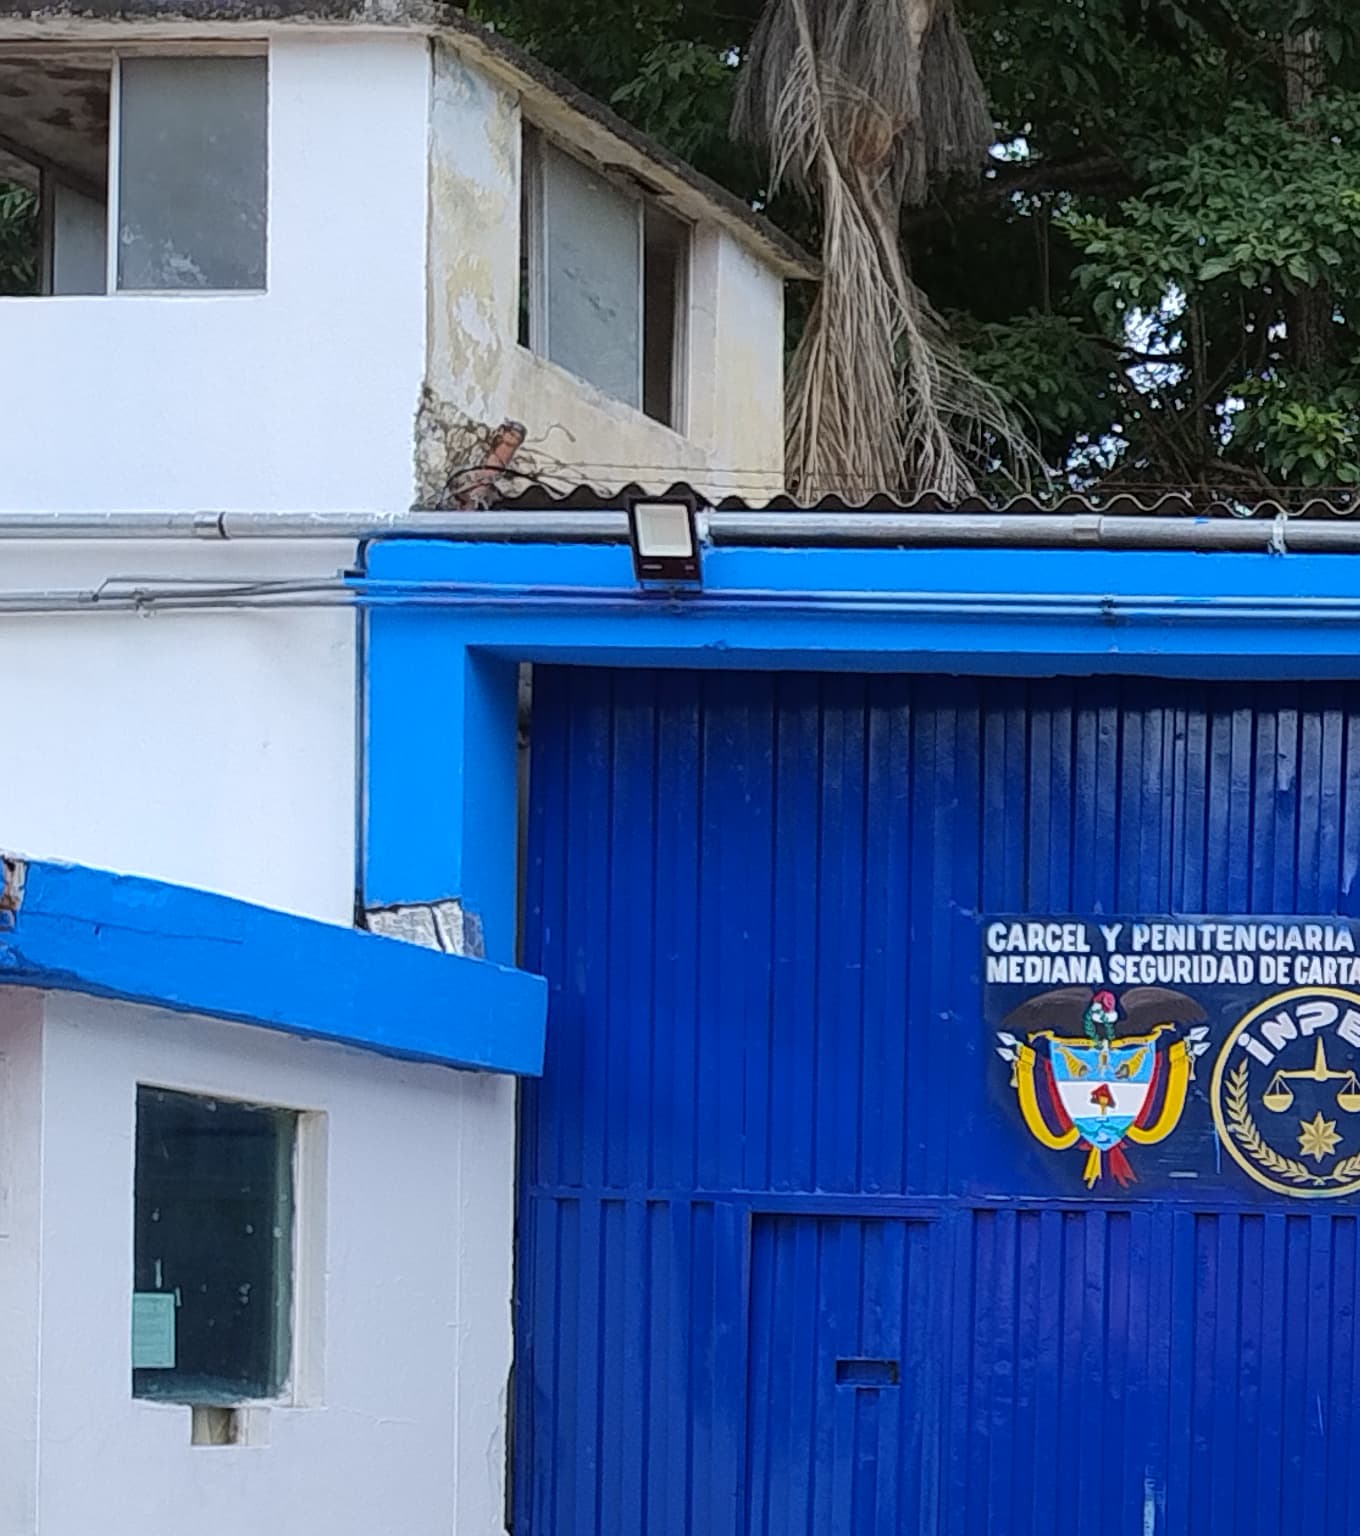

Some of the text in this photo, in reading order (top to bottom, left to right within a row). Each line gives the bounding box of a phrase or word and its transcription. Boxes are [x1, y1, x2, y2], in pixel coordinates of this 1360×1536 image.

[986, 923, 1090, 953] CARCEL
[1103, 925, 1124, 951] Y
[1132, 925, 1355, 952] PENITENCIARIA
[986, 954, 1104, 985] MEDIANA
[1109, 955, 1254, 985] SEGURIDAD
[1259, 956, 1291, 985] DE
